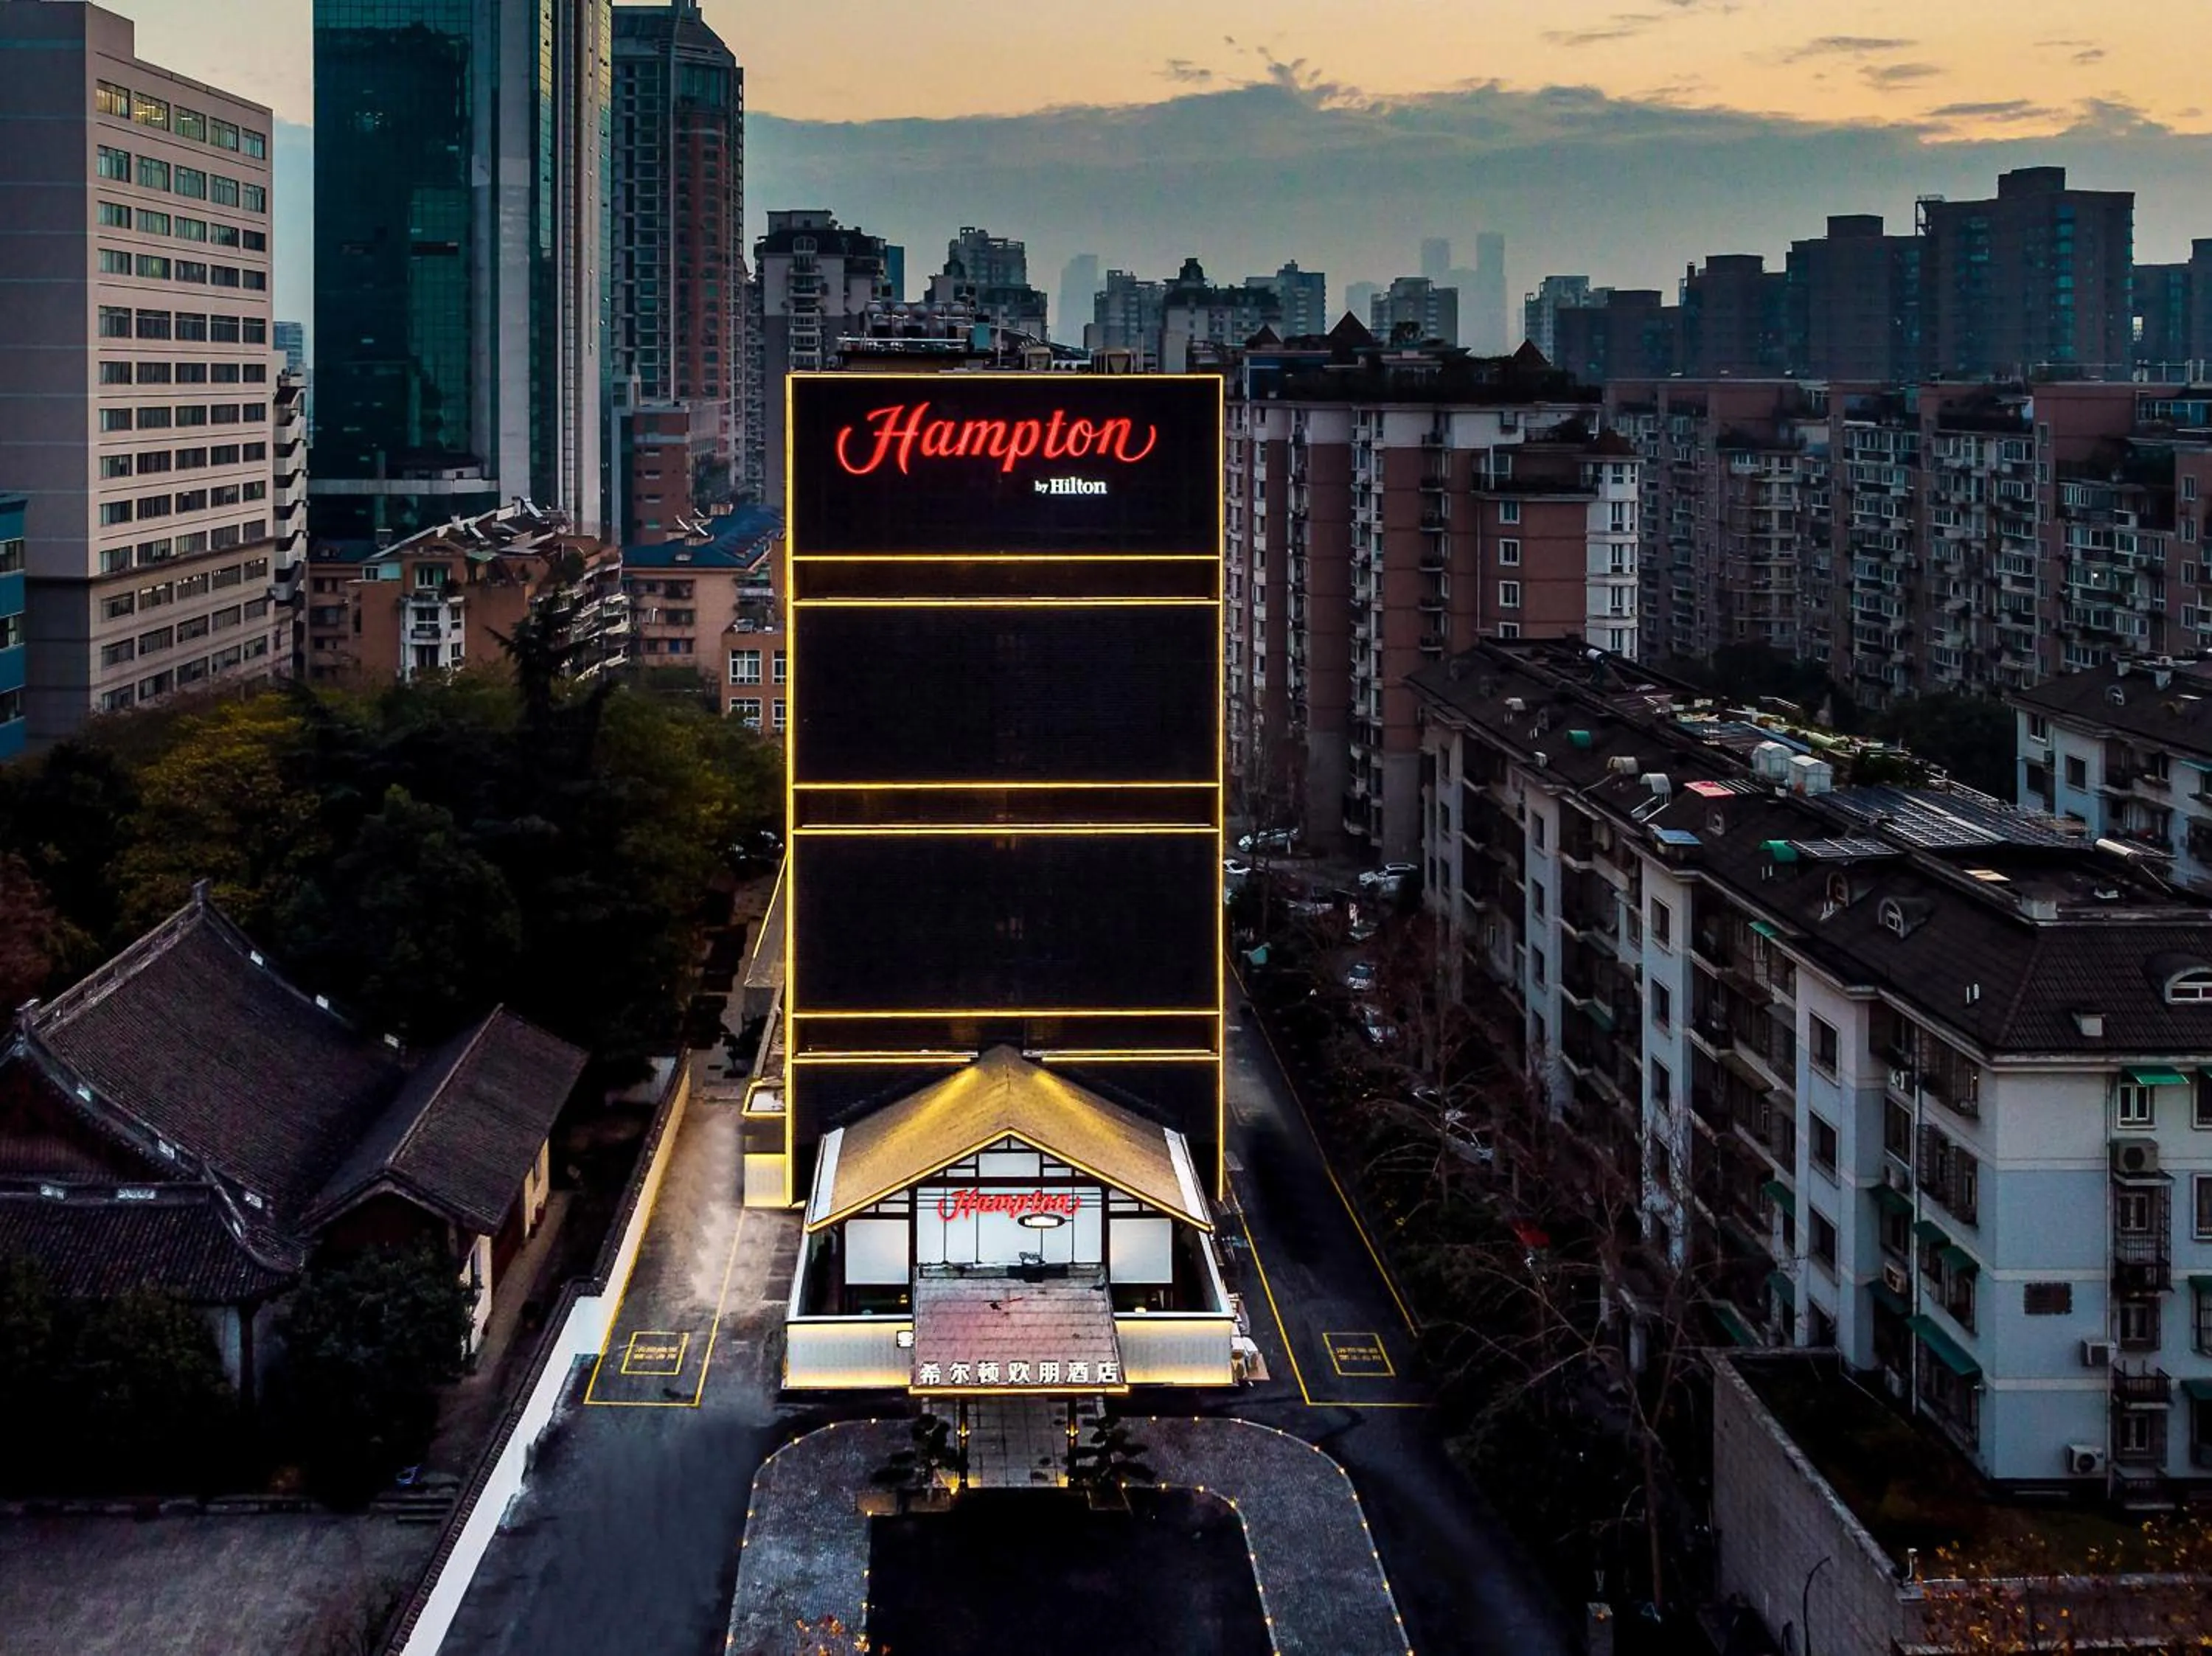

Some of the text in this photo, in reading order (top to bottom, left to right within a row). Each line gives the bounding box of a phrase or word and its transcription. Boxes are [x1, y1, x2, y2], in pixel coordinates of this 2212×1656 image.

[836, 400, 1157, 476] Hampton
[1034, 476, 1107, 494] by Hilton
[937, 1186, 1082, 1221] Hampton
[919, 1362, 1119, 1385] 希尔顿欢朋酒店
